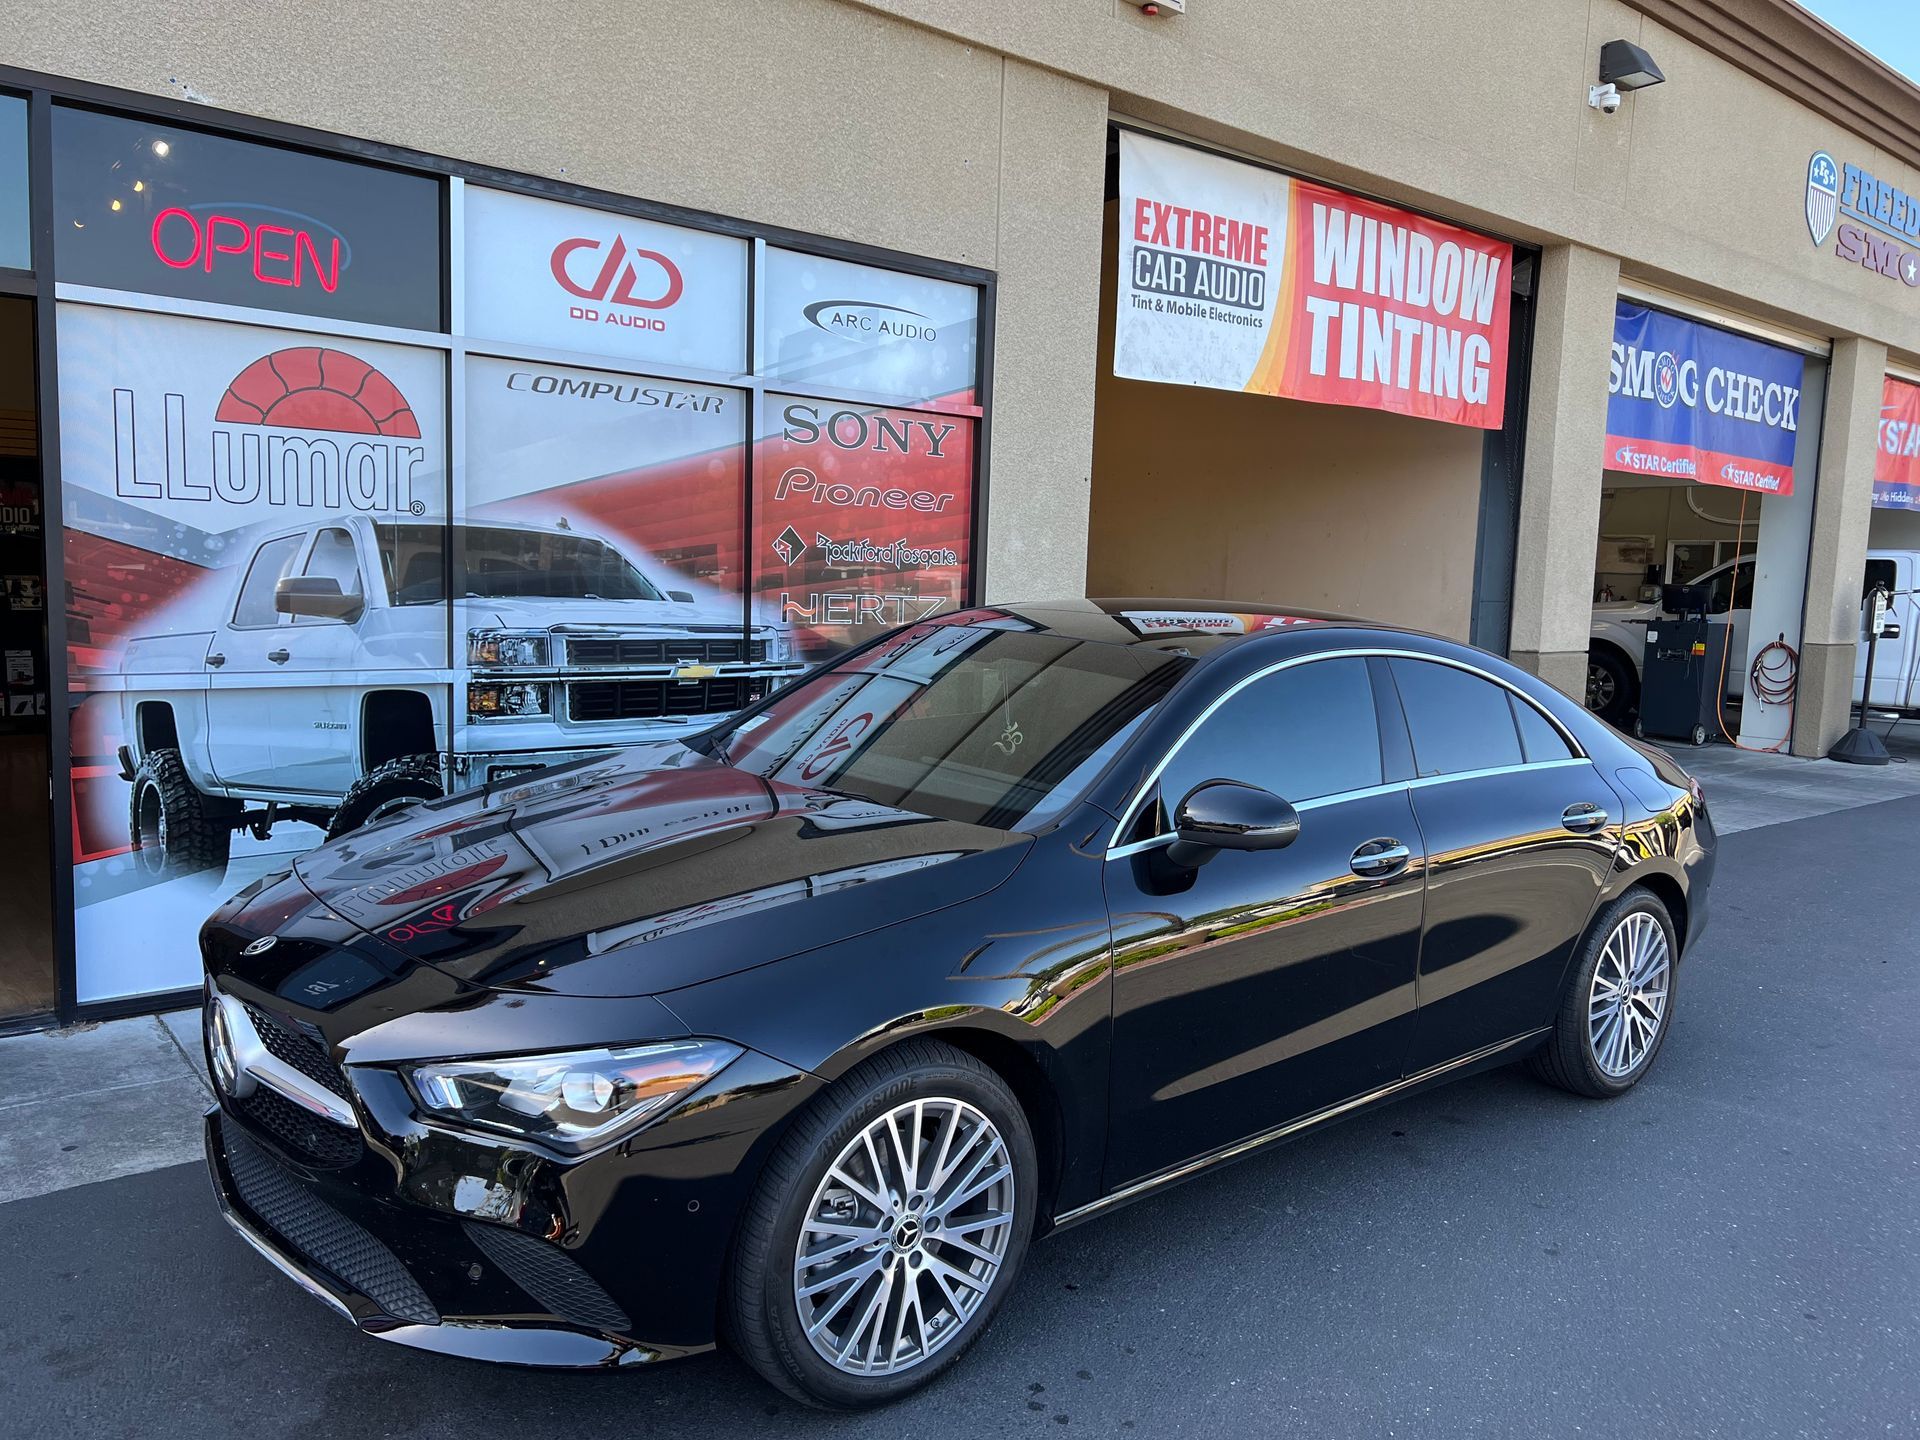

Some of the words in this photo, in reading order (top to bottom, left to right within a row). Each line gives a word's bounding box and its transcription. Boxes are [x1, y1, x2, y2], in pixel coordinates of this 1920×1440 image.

[1841, 162, 1920, 237] FREED
[151, 207, 340, 293] OPEN
[1133, 198, 1269, 266] EXTREME
[1135, 249, 1186, 294] CAR
[1193, 260, 1263, 307] AUDIO
[1312, 203, 1501, 326] WINDOW
[569, 306, 599, 322] DD
[605, 312, 666, 332] AUDIO
[831, 311, 872, 332] ARC
[878, 319, 937, 342] AUDIO
[1131, 294, 1153, 311] Tint
[1155, 298, 1164, 312] &
[1166, 300, 1207, 318] Mobile
[1209, 306, 1263, 328] Electronics
[1306, 295, 1491, 405] TINTING
[506, 372, 727, 415] COMPUSTAR
[1704, 367, 1799, 431] CHECK
[782, 404, 957, 458] SONY
[1885, 419, 1920, 458] STA
[1633, 453, 1660, 471] STAR
[1734, 470, 1754, 486] STAR
[1755, 473, 1780, 490] Certified
[775, 467, 955, 512] Pioneer
[0, 506, 30, 524] DIO
[780, 592, 947, 625] HERTZ
